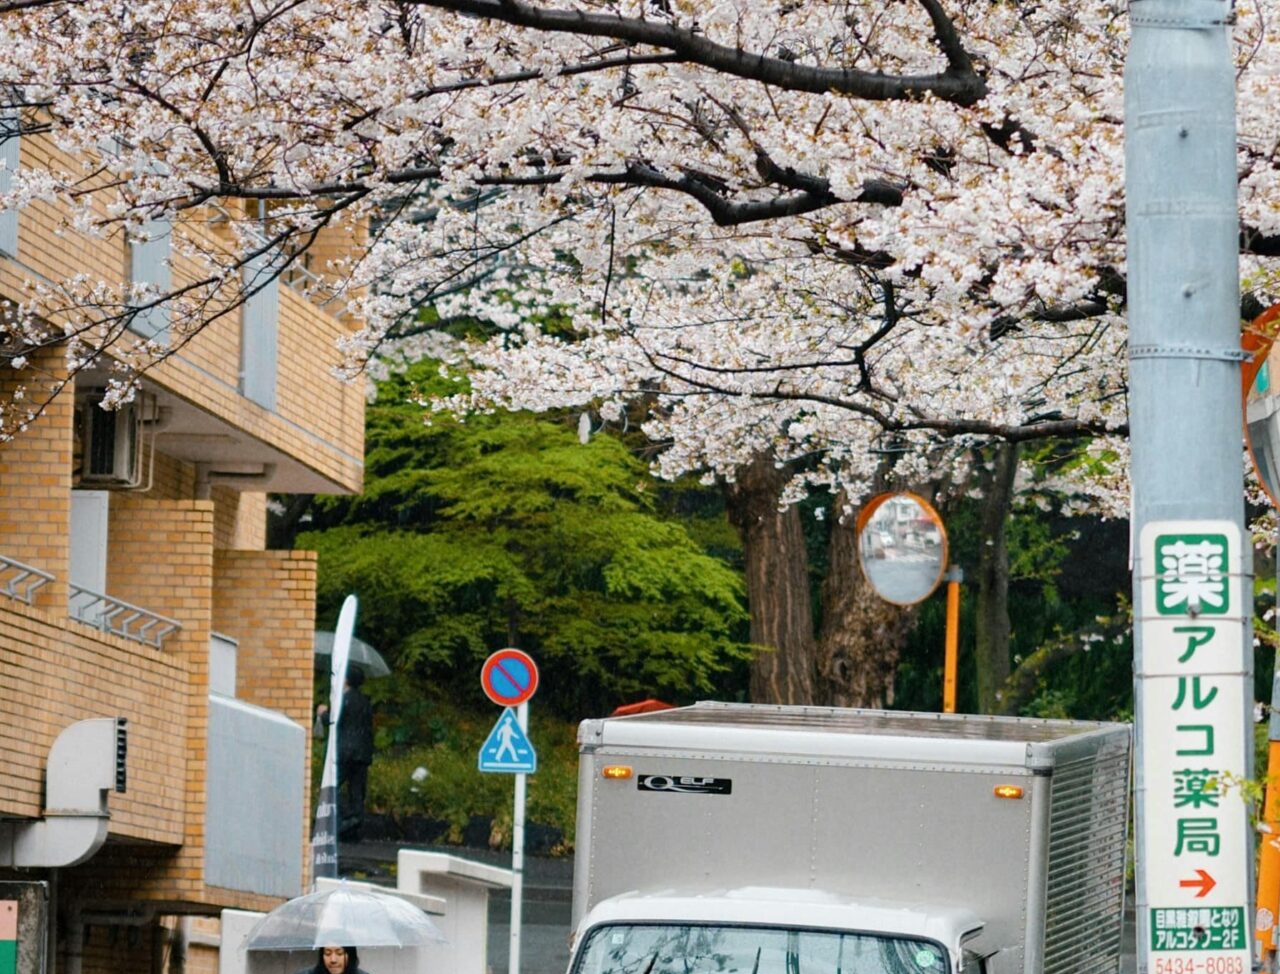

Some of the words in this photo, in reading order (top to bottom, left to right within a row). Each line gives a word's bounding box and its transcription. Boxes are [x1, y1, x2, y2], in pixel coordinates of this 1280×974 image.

[1160, 540, 1224, 609] 薬
[1171, 625, 1221, 857] アルコ薬局
[1156, 957, 1243, 974] 5434-8083
